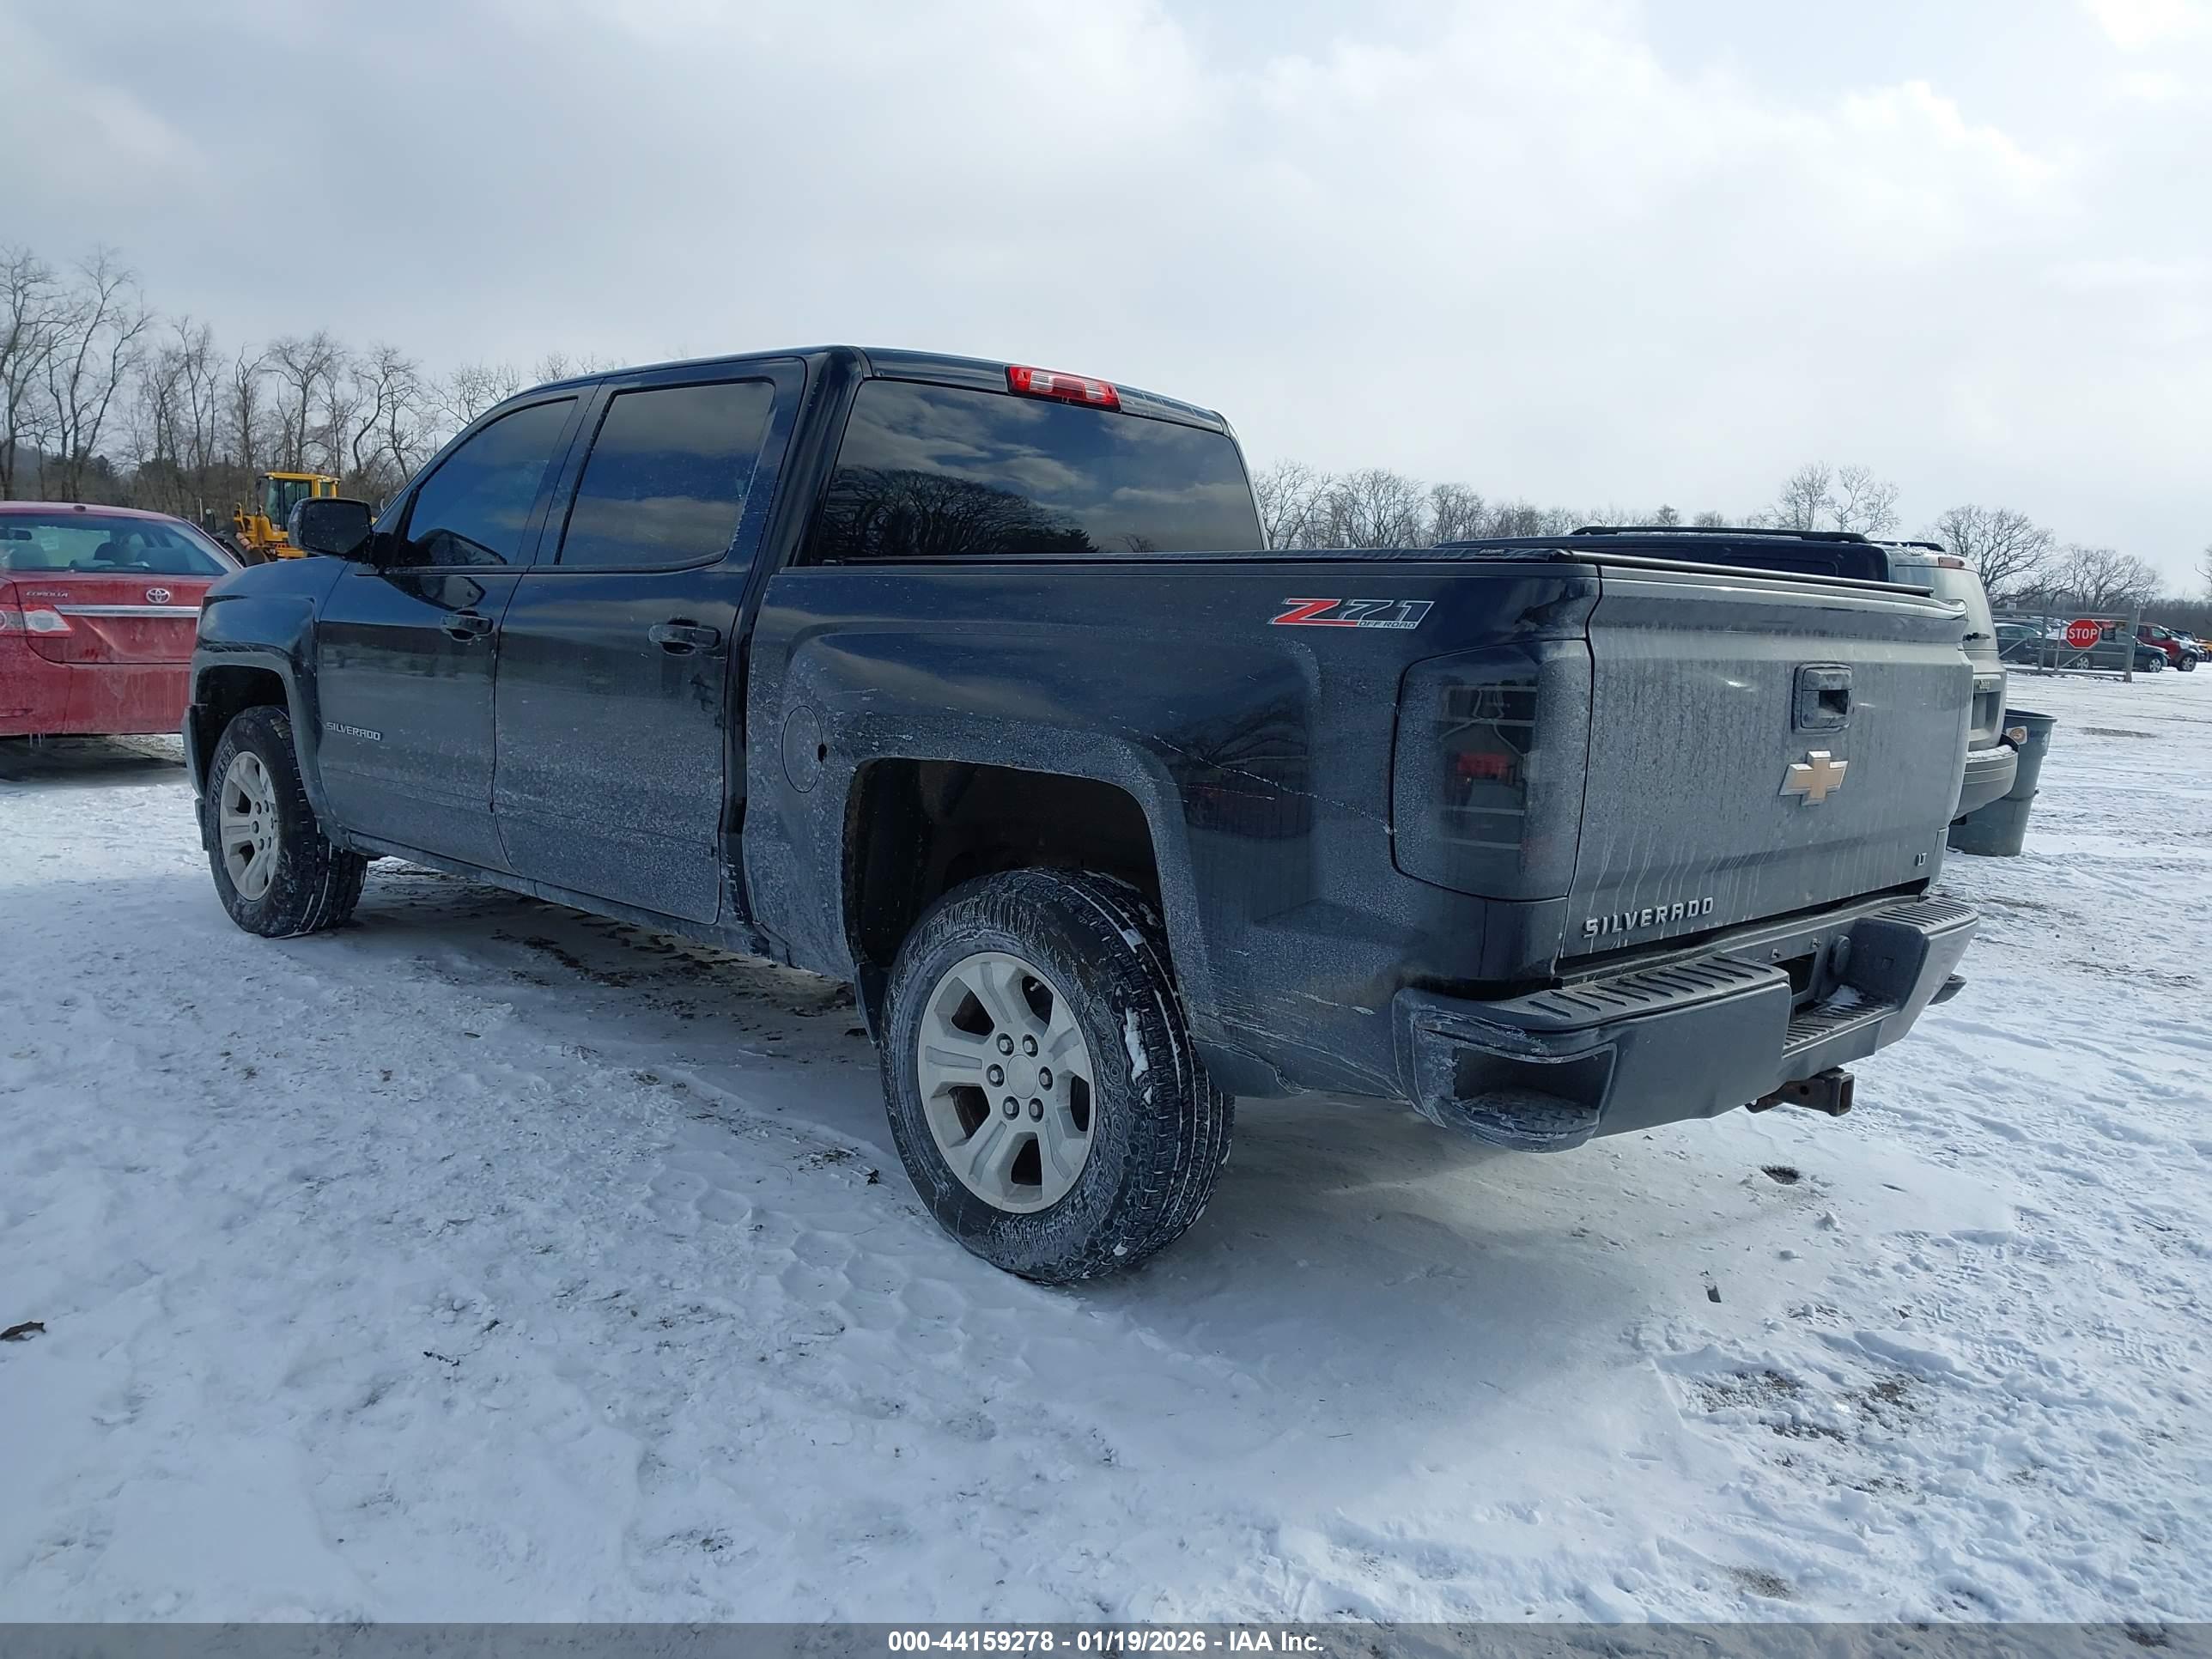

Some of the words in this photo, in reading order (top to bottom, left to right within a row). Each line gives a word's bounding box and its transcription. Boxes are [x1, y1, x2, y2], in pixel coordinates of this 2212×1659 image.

[1268, 598, 1435, 626] Z71
[2068, 628, 2098, 640] STOP
[326, 721, 381, 741] SILVERADO
[1583, 896, 1713, 939] SILVERADO
